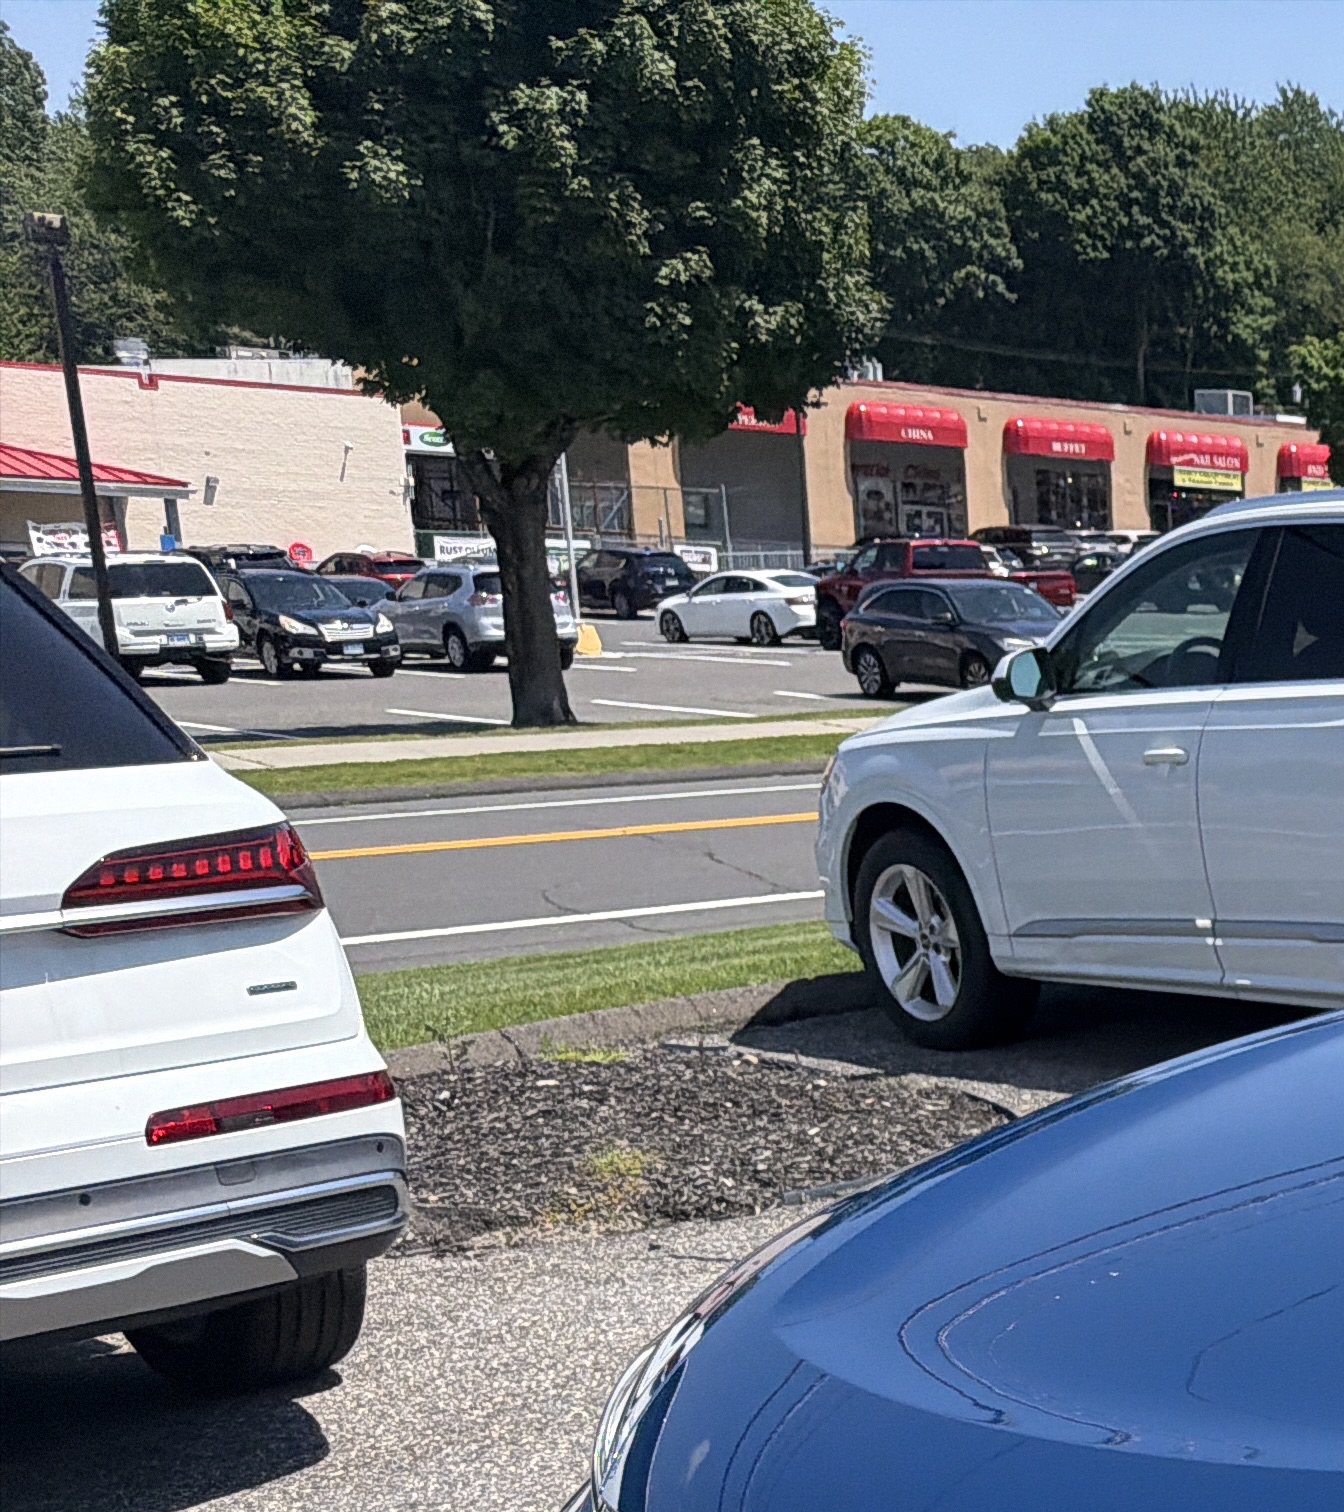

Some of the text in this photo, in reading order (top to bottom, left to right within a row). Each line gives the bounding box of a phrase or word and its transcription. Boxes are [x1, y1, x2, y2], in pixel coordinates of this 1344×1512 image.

[900, 428, 934, 441] CHINA
[1051, 441, 1086, 455] BUFFET
[439, 545, 463, 556] RUST
